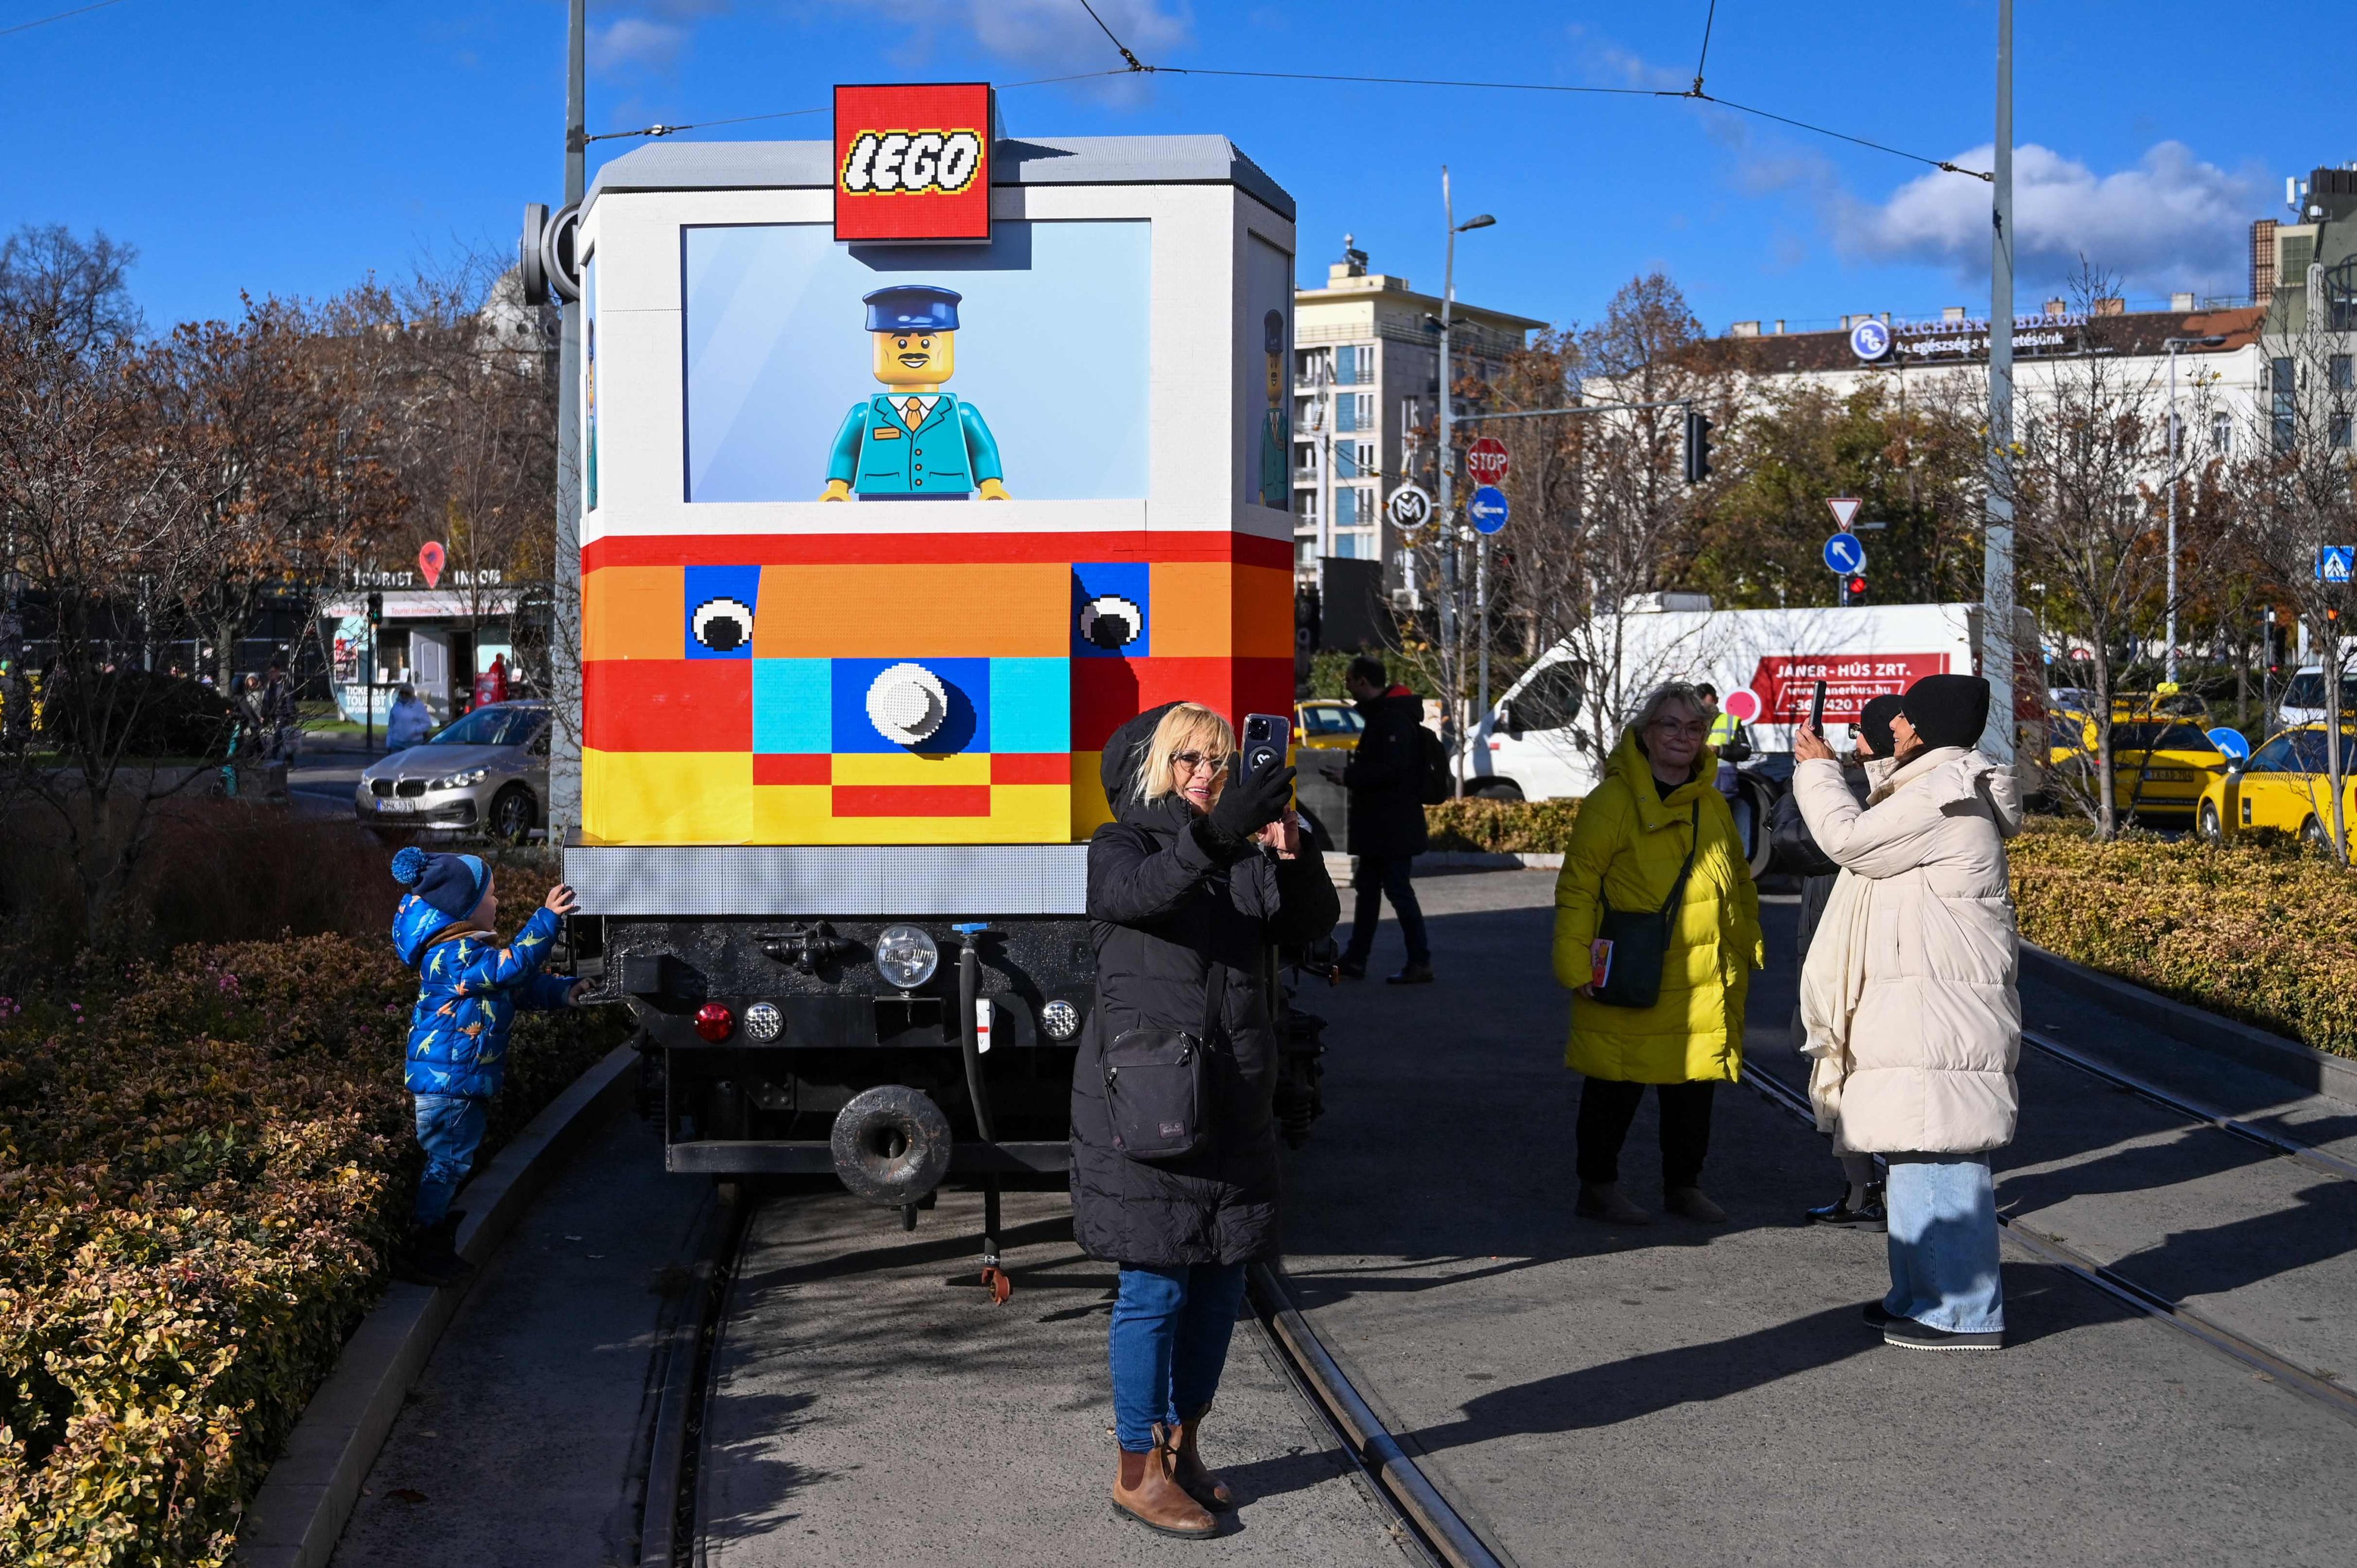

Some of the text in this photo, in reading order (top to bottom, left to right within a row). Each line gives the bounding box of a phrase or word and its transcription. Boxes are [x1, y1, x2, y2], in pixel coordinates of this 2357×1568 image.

[840, 129, 984, 196] LEGO
[1469, 452, 1507, 471] STOP
[353, 571, 413, 586] TOURIST
[1875, 663, 1911, 676] ZRT.
[346, 695, 386, 707] TOUIST
